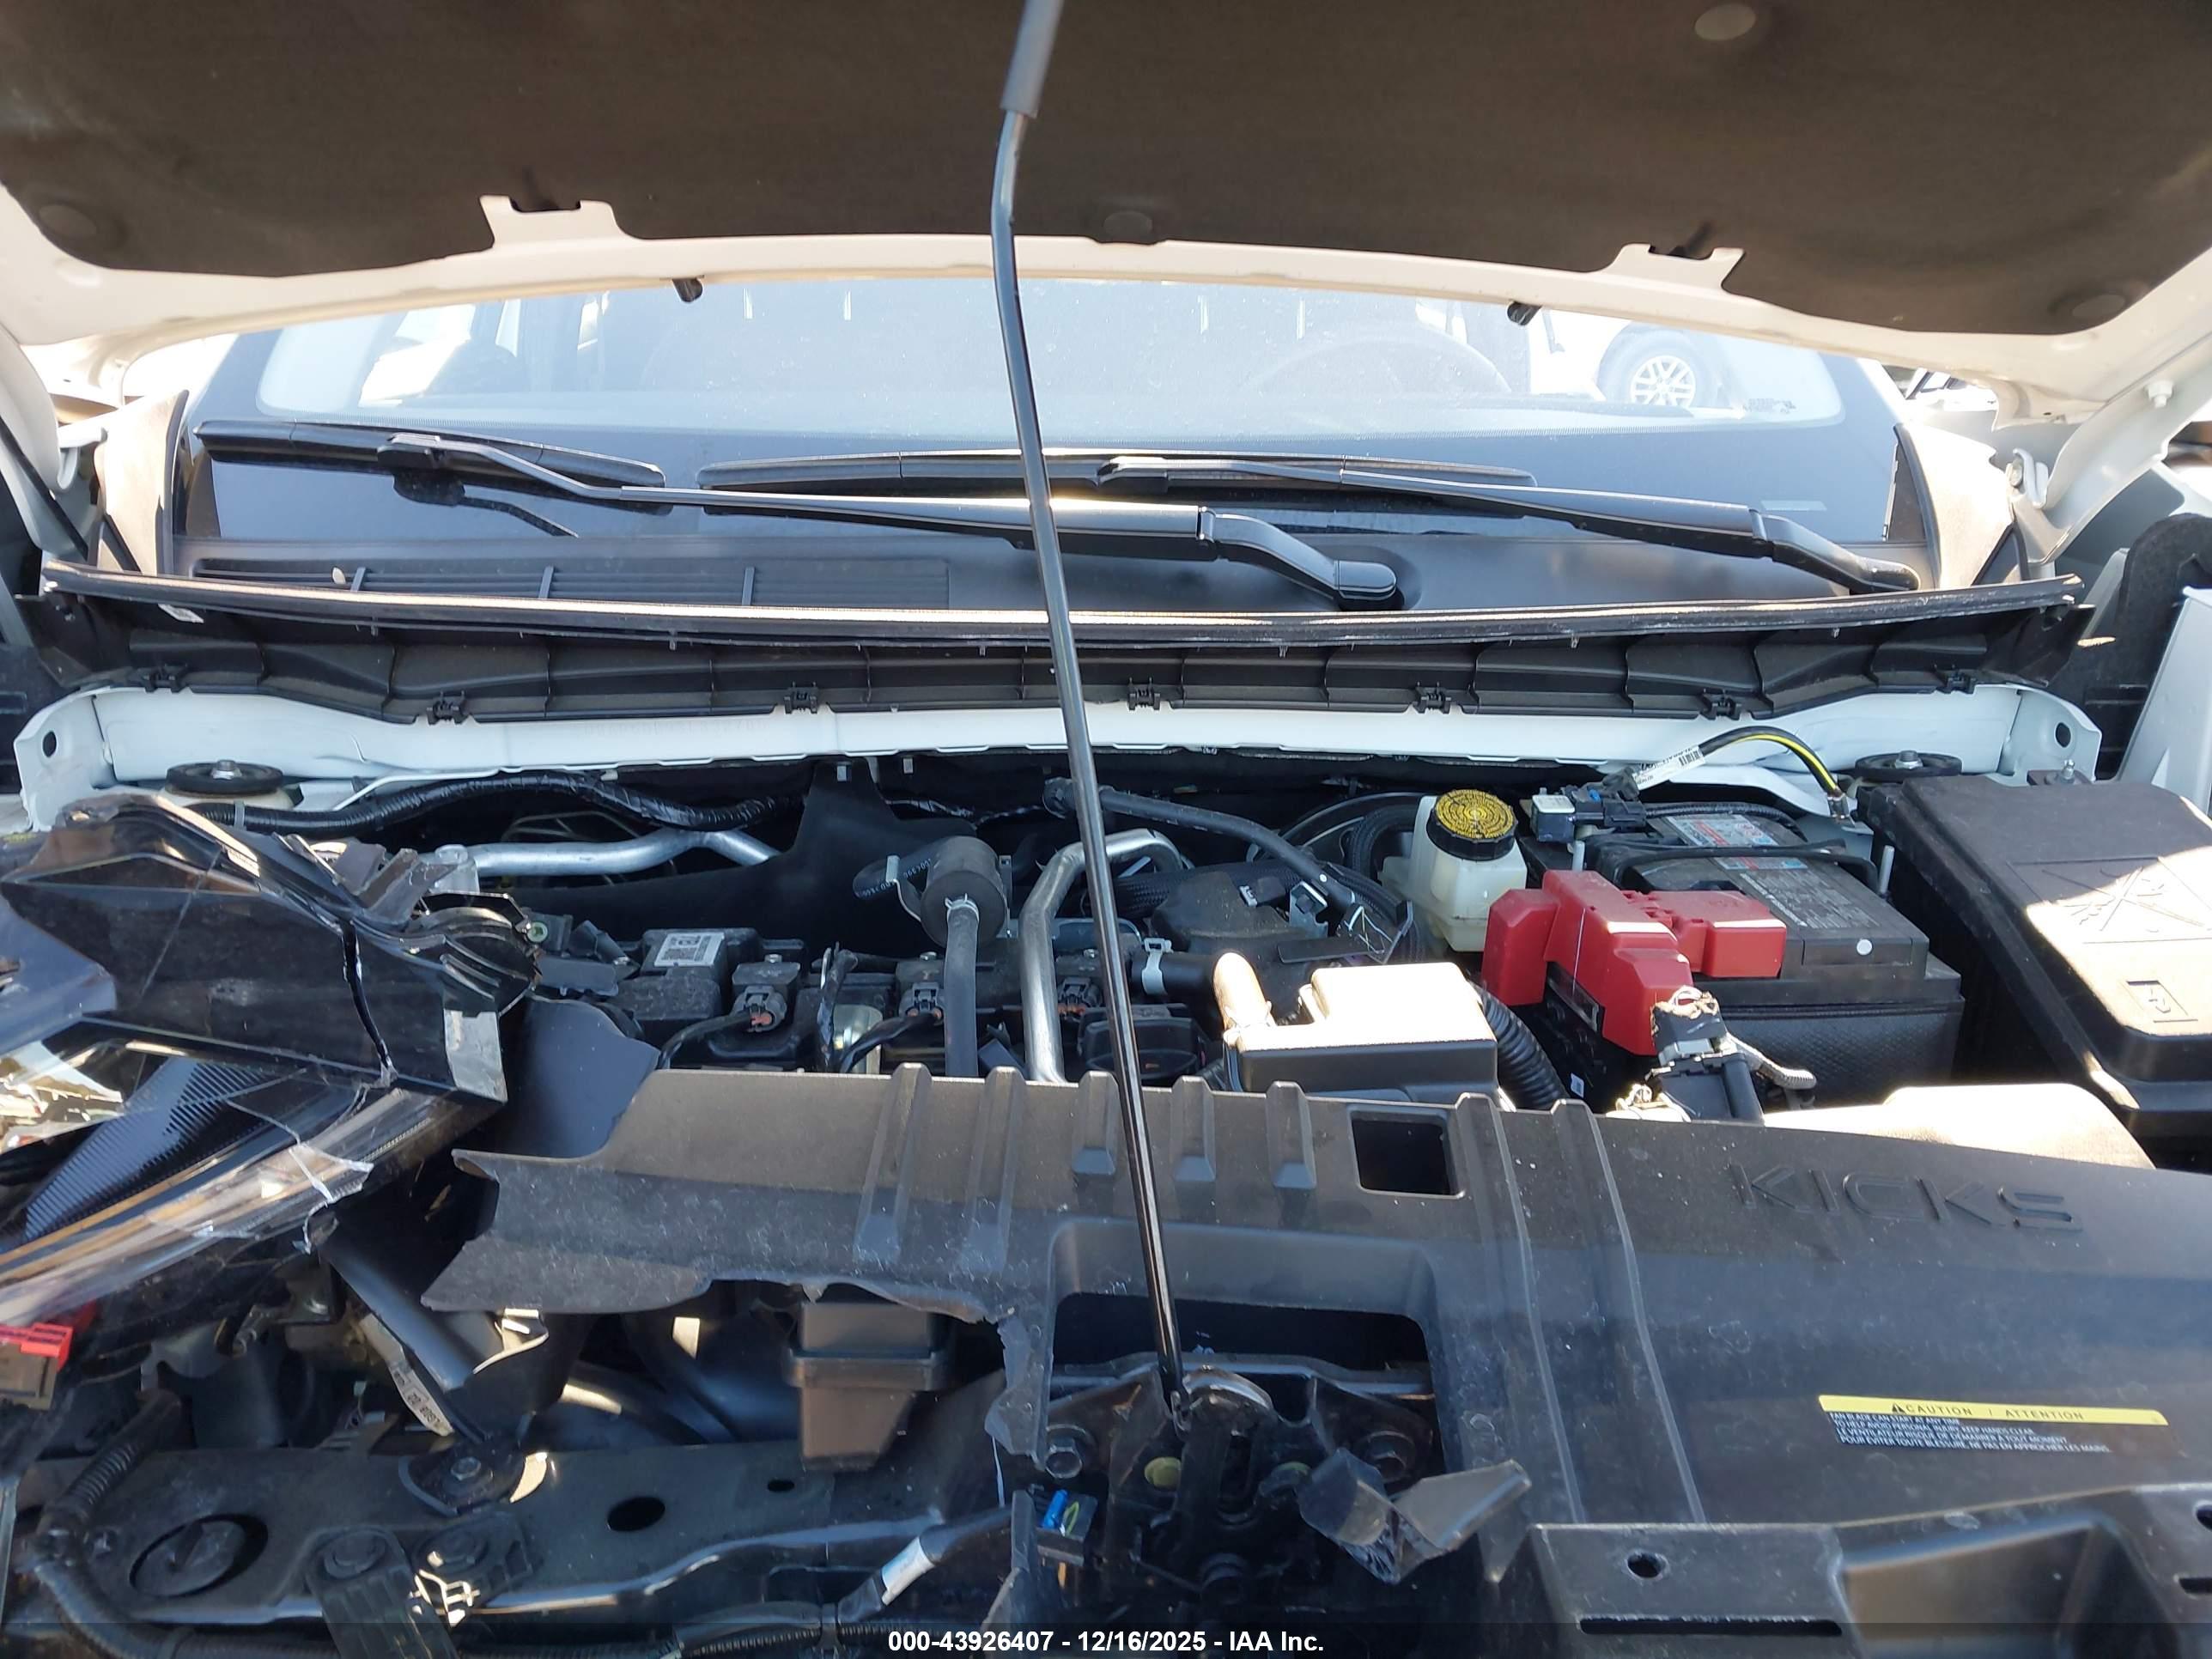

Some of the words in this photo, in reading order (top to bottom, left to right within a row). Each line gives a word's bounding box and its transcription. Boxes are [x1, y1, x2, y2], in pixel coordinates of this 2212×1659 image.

[1726, 1163, 2083, 1232] KICKS
[1905, 1403, 1973, 1416] CAUTION
[2005, 1410, 2084, 1421] ATTENTION
